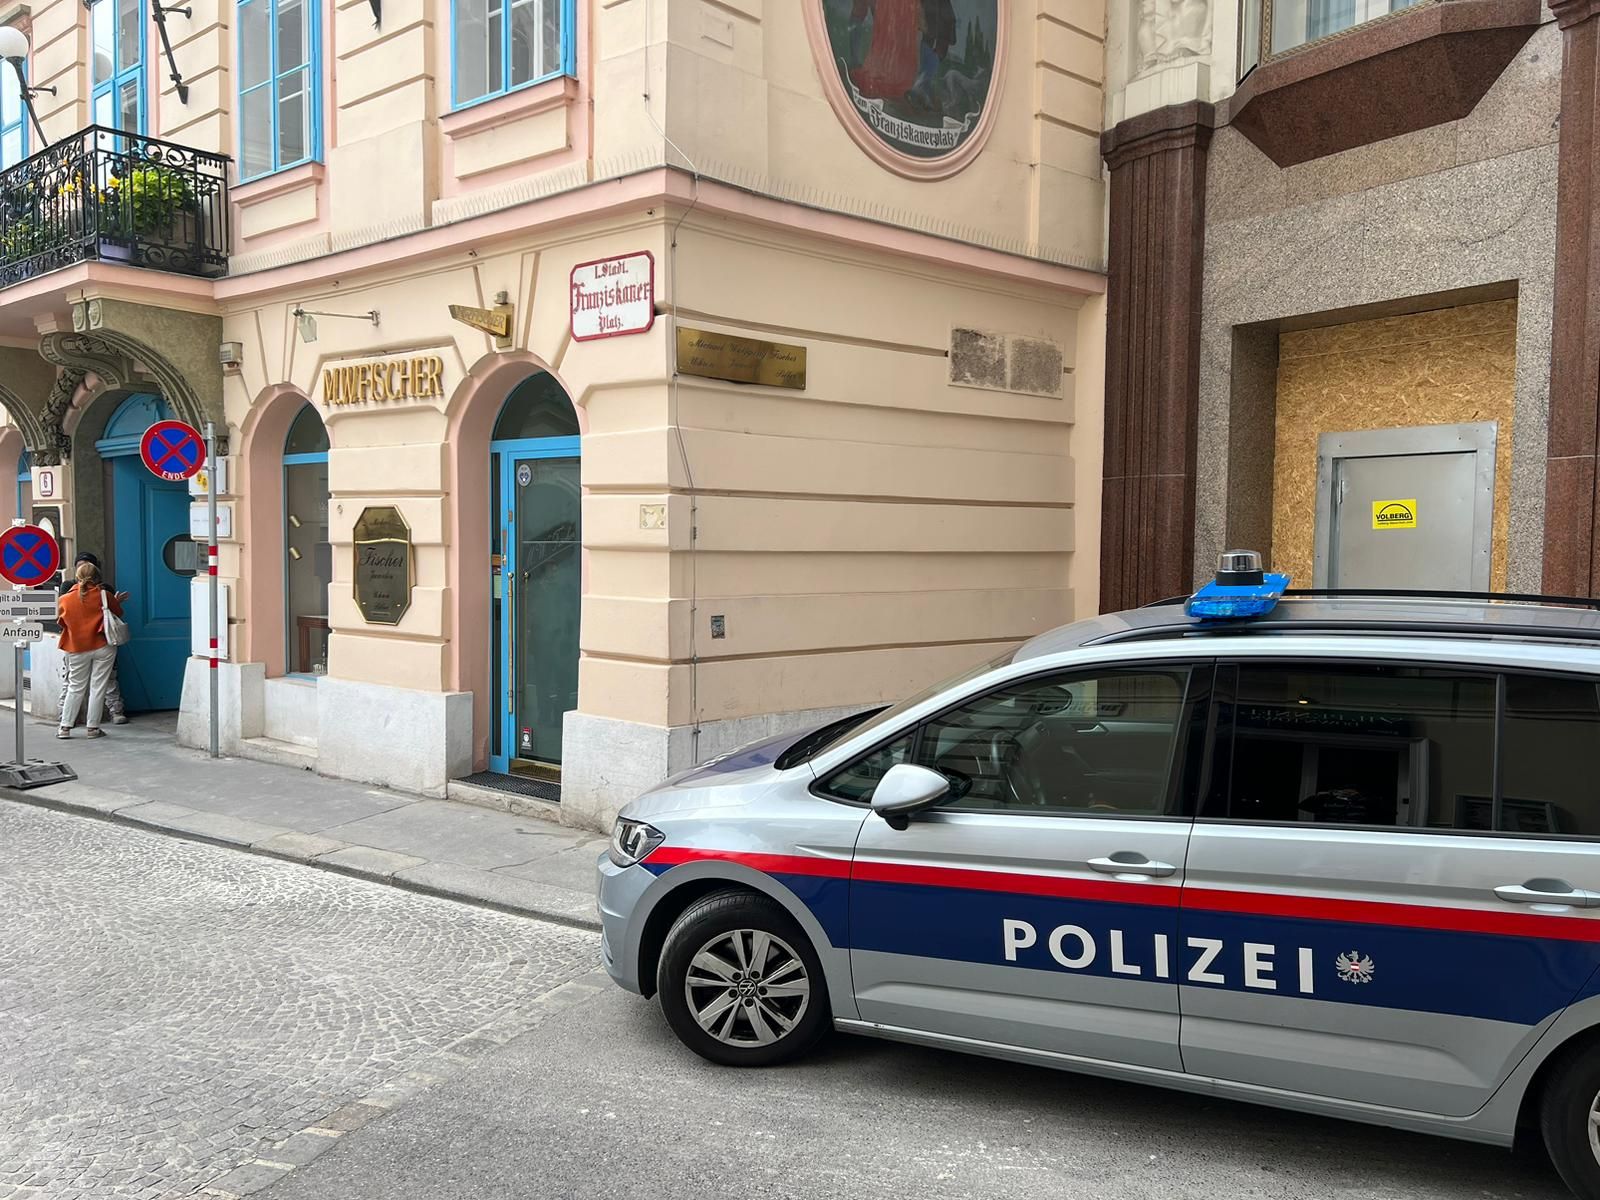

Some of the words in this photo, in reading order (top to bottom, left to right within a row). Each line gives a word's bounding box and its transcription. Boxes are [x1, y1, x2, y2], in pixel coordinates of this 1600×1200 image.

[162, 470, 186, 480] ENDE
[1375, 512, 1410, 520] VOLBERG
[360, 547, 404, 569] Fischer
[11, 594, 21, 602] ab
[28, 608, 39, 616] bis
[3, 627, 40, 639] Anfang
[1002, 918, 1315, 994] POLIZEI
